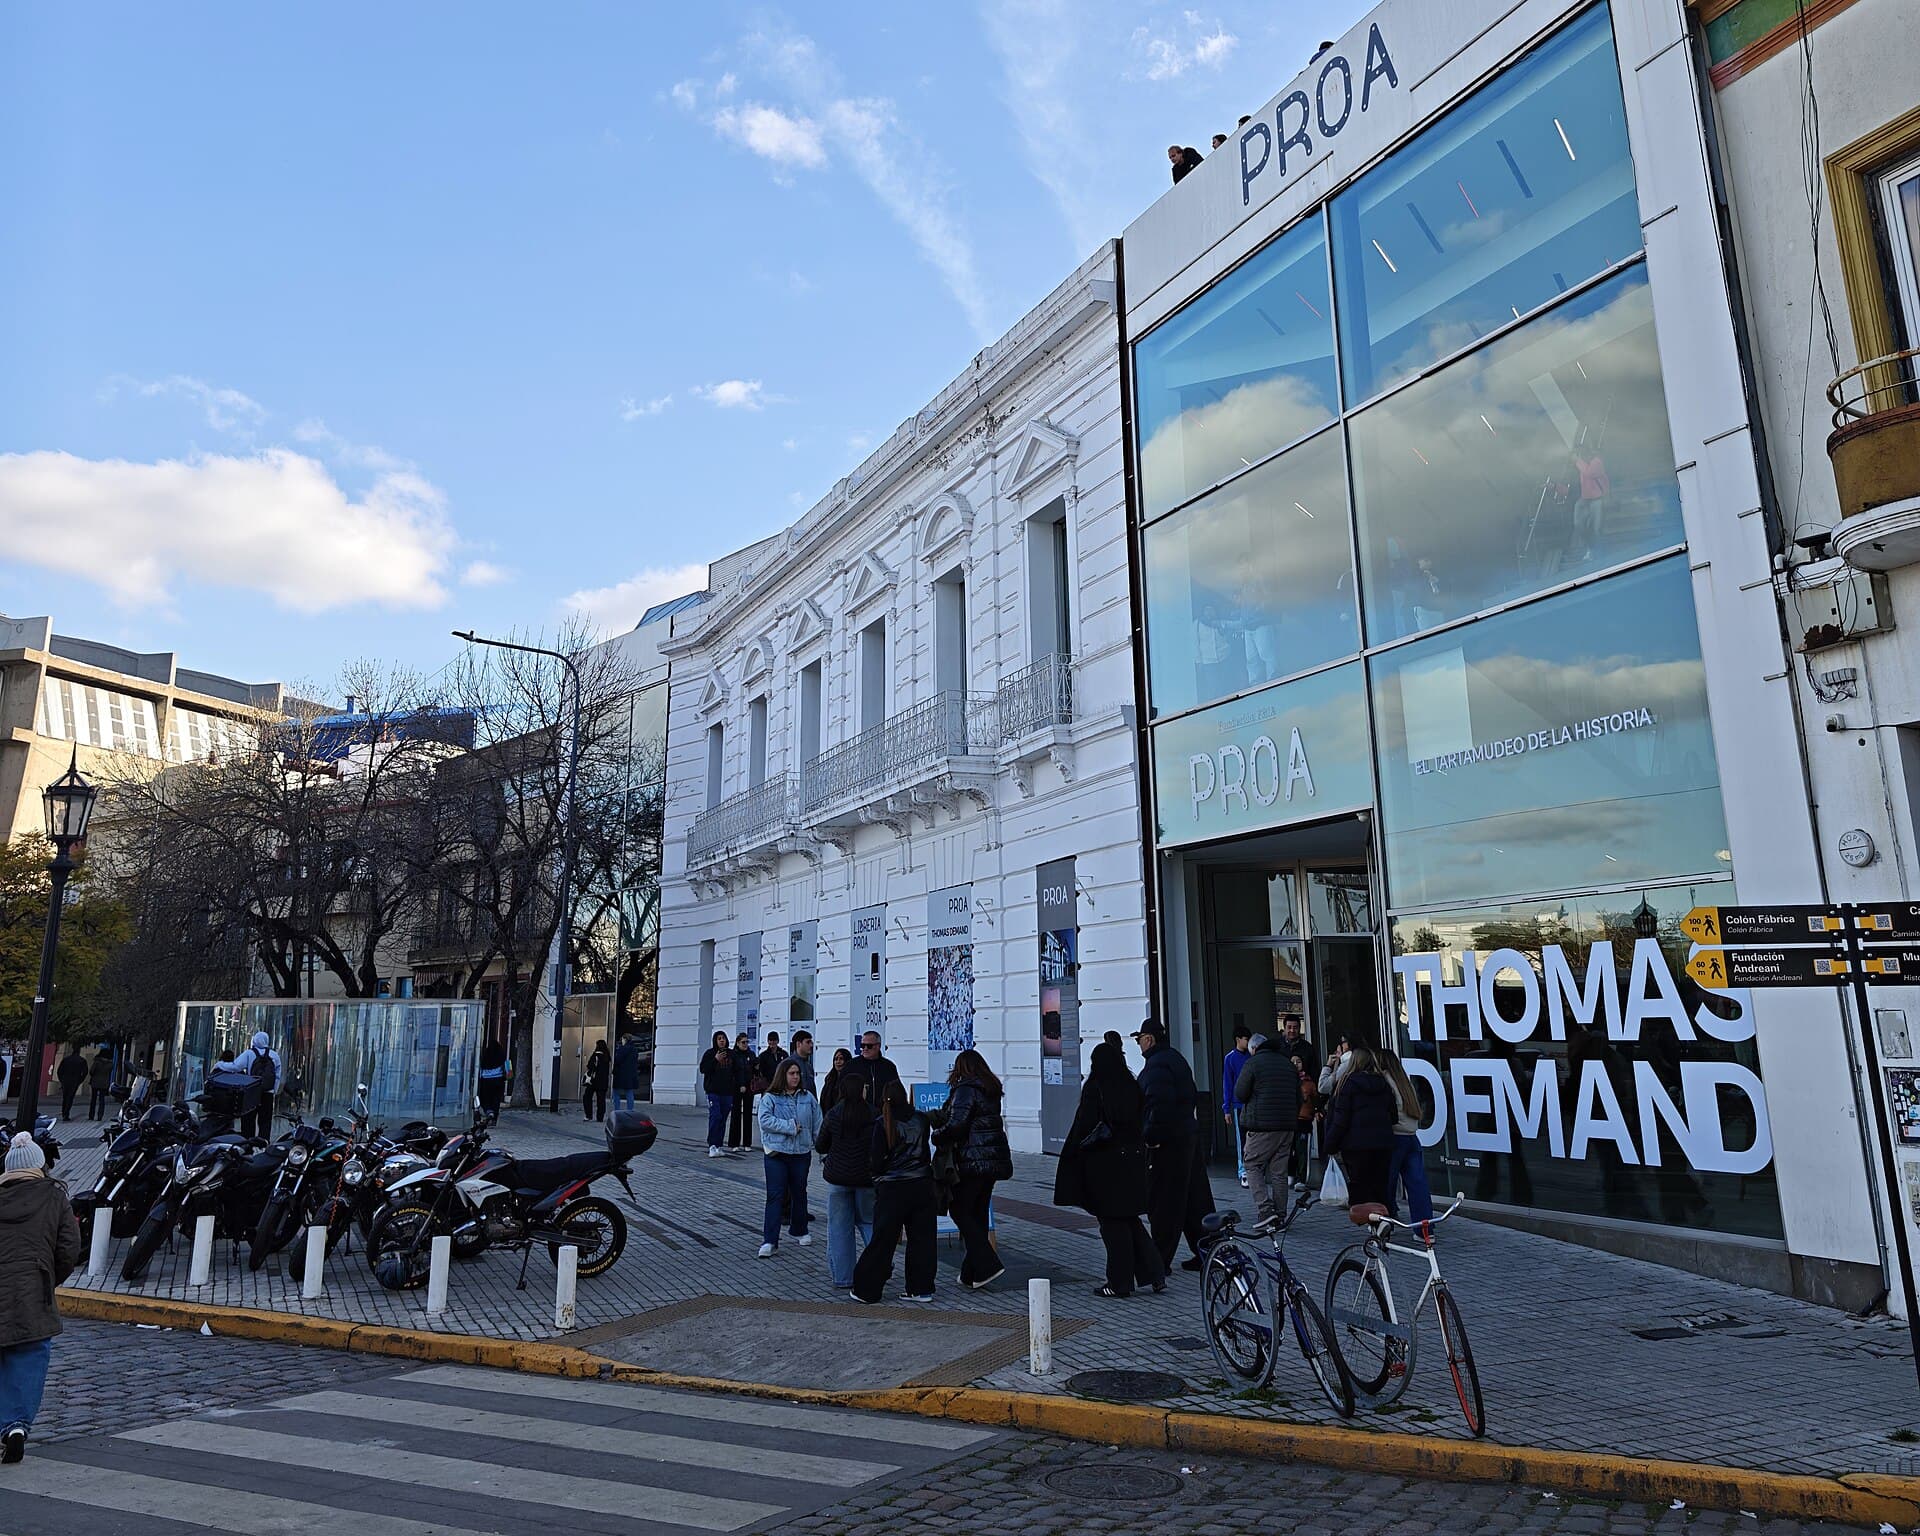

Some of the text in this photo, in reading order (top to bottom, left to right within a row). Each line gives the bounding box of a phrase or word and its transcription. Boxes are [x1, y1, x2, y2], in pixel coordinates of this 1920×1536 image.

[1240, 22, 1399, 206] PROA
[1415, 707, 1653, 776] EL TARTAMUDEO DE LA HISTORIA
[1189, 726, 1316, 822] PROA
[1043, 885, 1068, 908] PROA
[948, 896, 969, 915] PROA
[853, 916, 882, 935] LIBRERIA
[1726, 914, 1796, 925] Colón Fábrica
[931, 924, 969, 938] THOMAS DEMAND
[1727, 926, 1748, 934] Colón
[853, 935, 869, 950] PROA
[1731, 951, 1785, 962] Fundación
[1733, 963, 1780, 974] Andreani
[1734, 973, 1803, 983] Fundación Andreani
[1393, 937, 1756, 1044] THOMAS
[866, 994, 882, 1010] CAFE
[865, 1011, 882, 1026] PROA
[920, 1092, 946, 1104] CAFE
[1401, 1058, 1774, 1175] DEMAND
